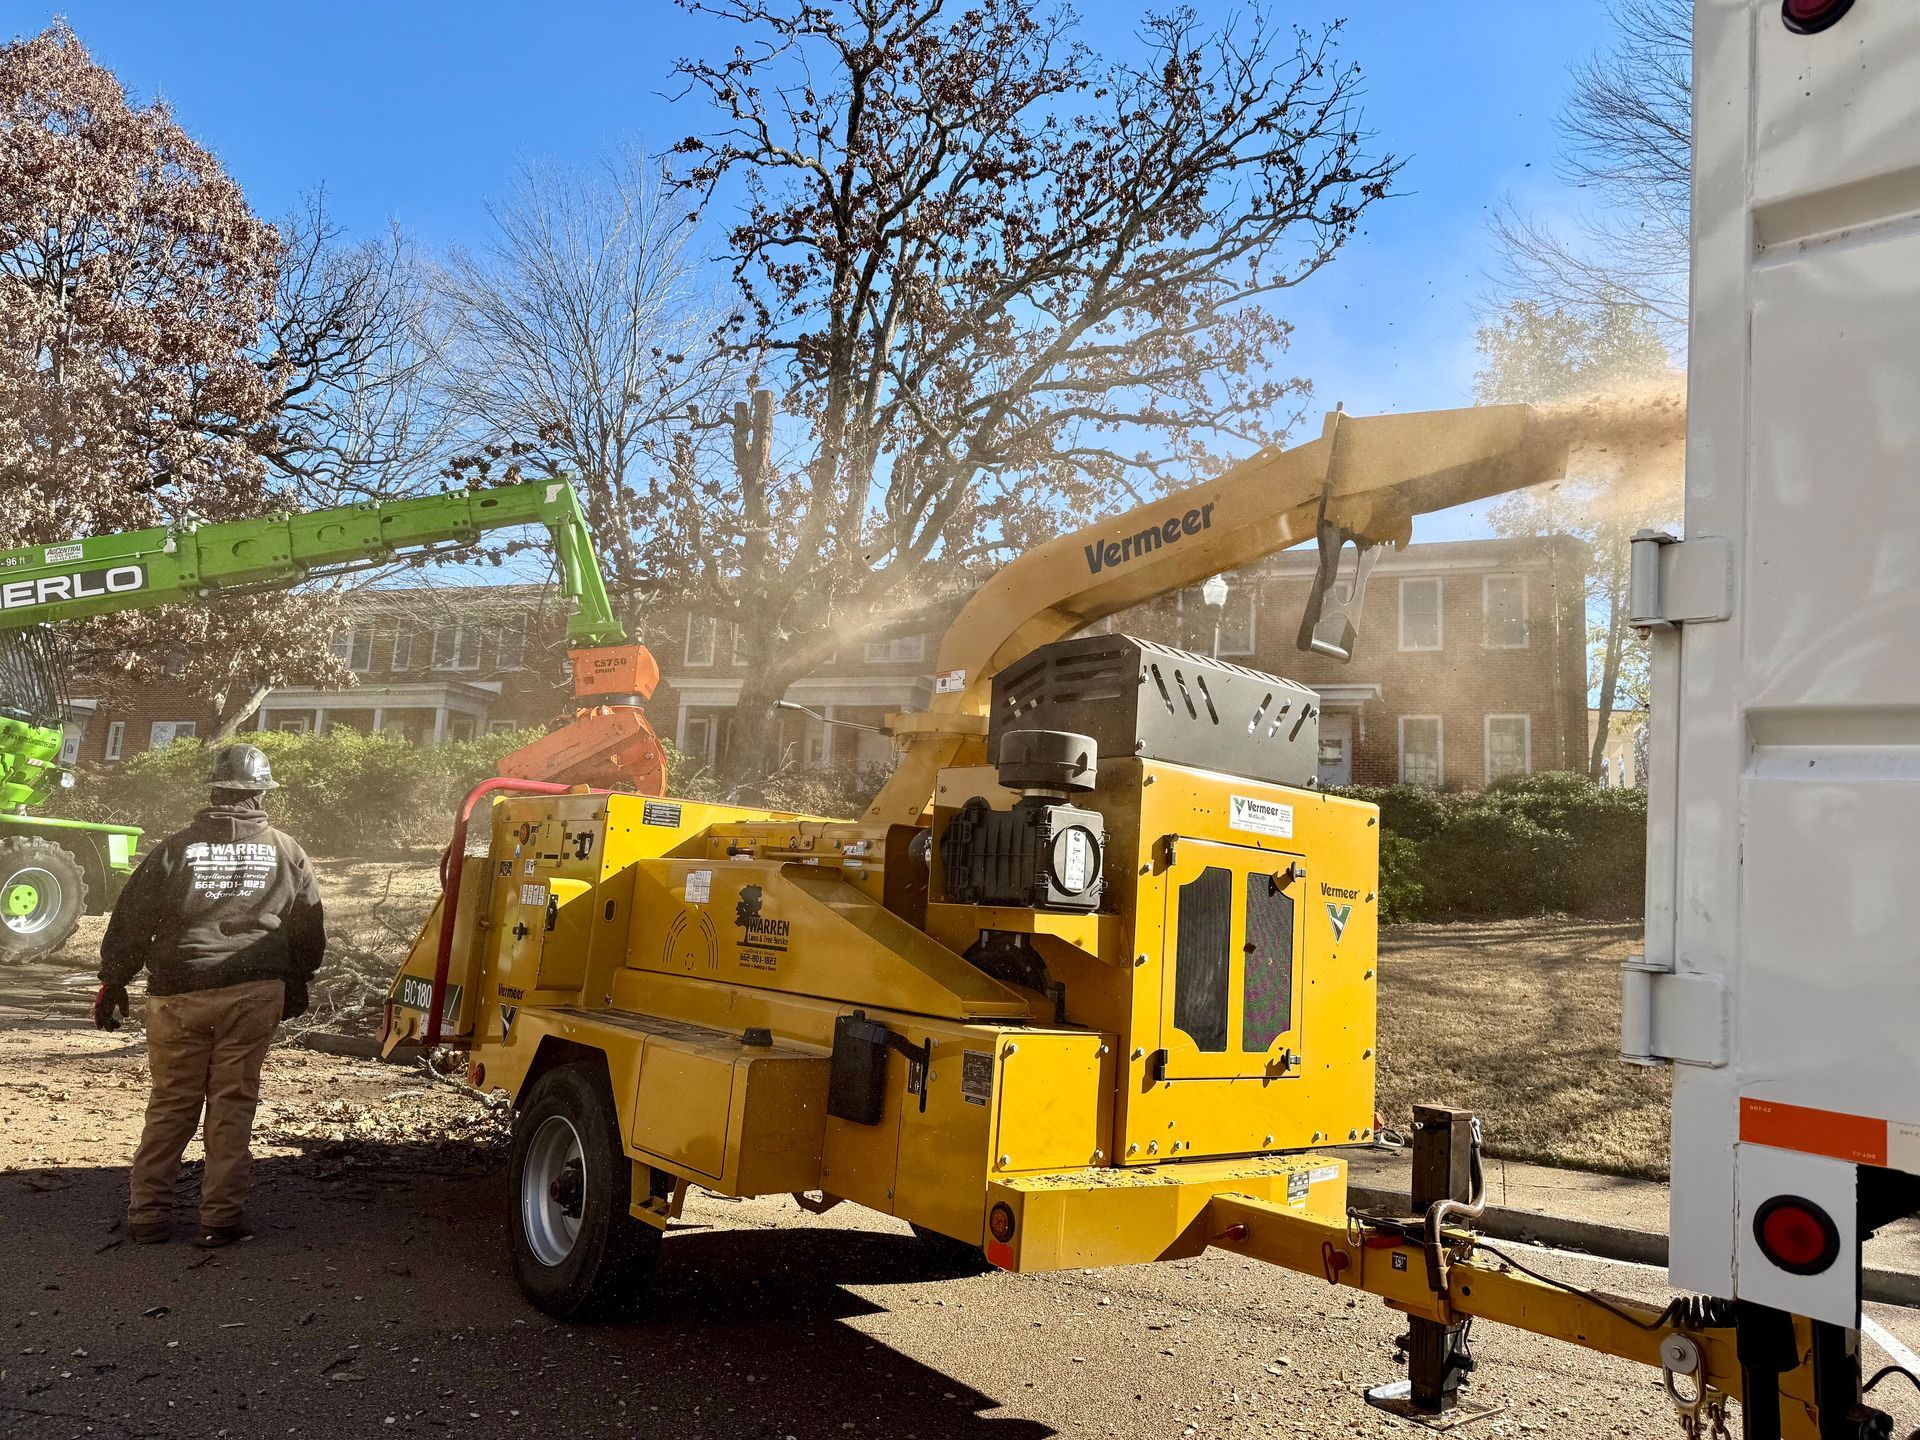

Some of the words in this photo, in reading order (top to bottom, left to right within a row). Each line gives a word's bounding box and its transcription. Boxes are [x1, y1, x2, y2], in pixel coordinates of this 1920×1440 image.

[1084, 502, 1214, 574] Vermeer
[6, 558, 17, 566] 96
[19, 556, 26, 564] ft
[0, 565, 142, 609] ERLO
[1247, 800, 1279, 816] Vermeer
[211, 843, 276, 857] WARREN
[194, 880, 266, 889] 662-801-1823
[1320, 882, 1358, 900] Vermeer
[748, 917, 790, 936] WARREN
[498, 983, 525, 1000] Vermeer
